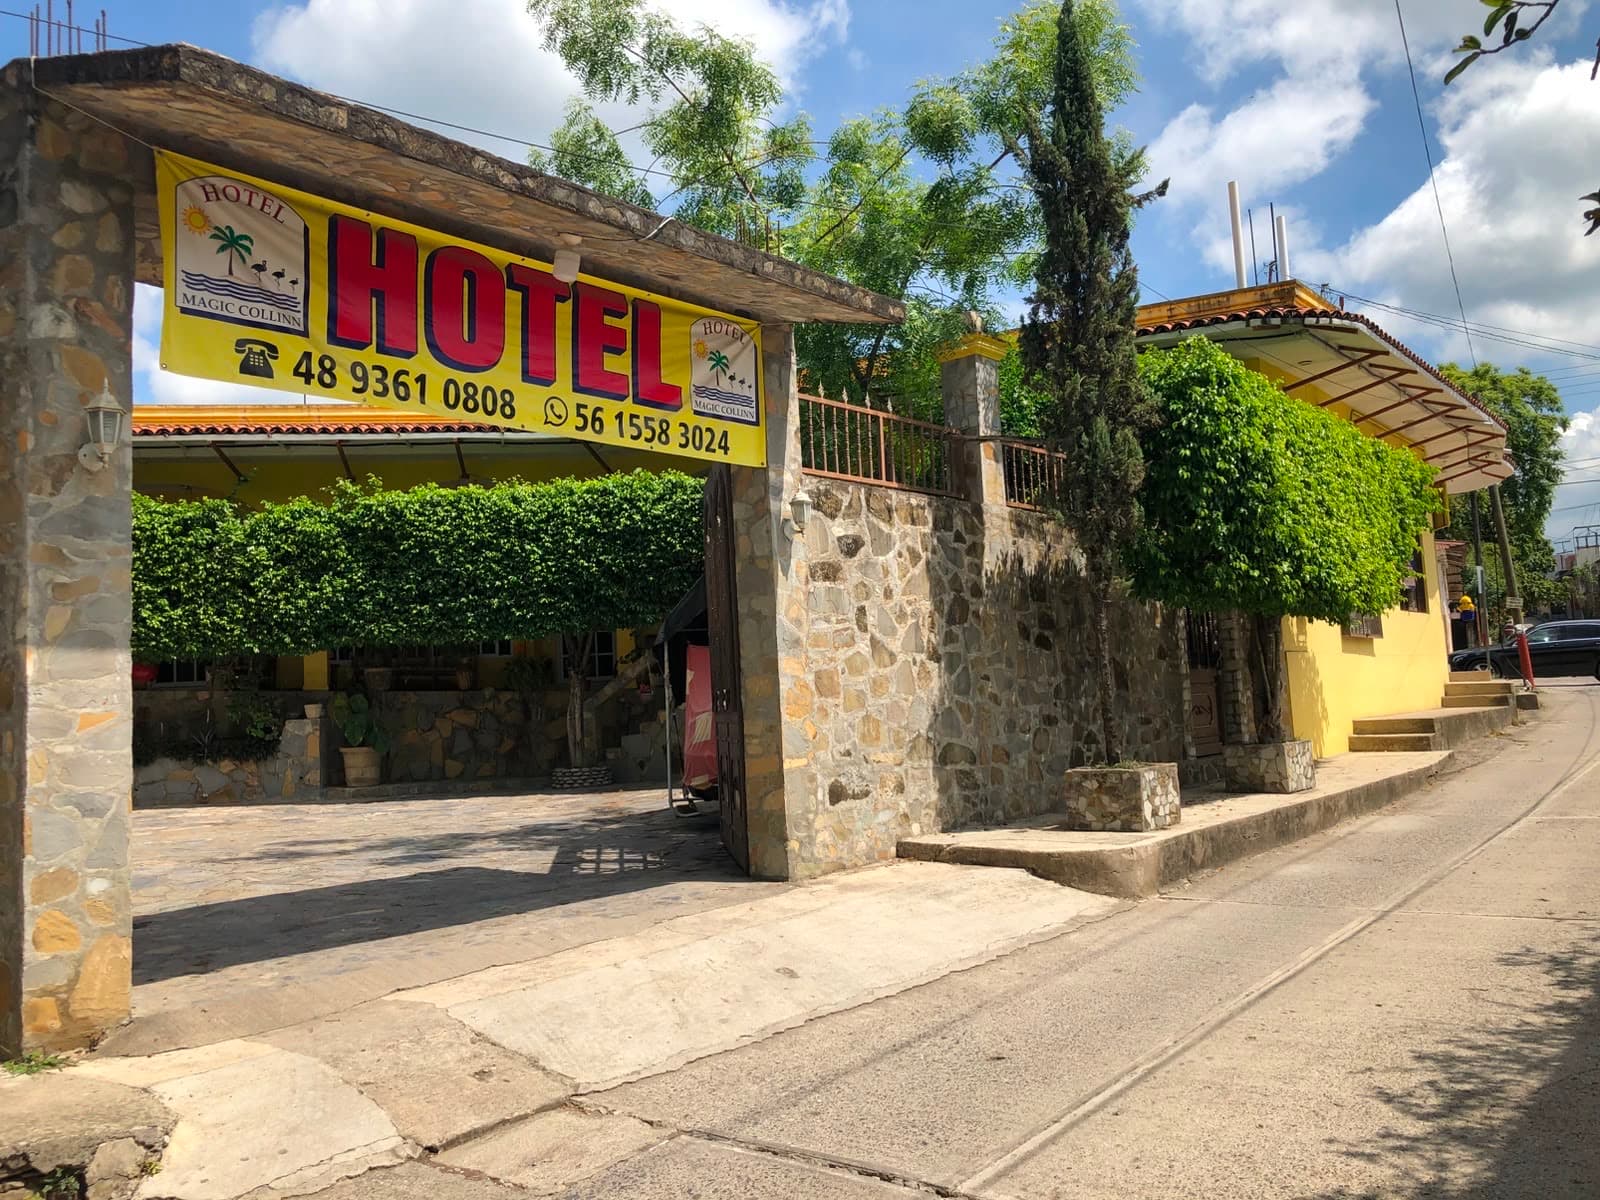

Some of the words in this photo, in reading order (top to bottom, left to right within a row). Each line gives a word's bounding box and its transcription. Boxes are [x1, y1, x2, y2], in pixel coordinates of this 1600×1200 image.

[200, 183, 286, 225] HOTEL
[182, 292, 235, 315] MAGIC
[238, 304, 302, 328] COLLINN
[327, 213, 683, 412] HOTEL
[702, 320, 748, 346] HOTEL
[292, 350, 338, 389] 48
[350, 360, 427, 405] 9361
[442, 377, 516, 420] 0808
[574, 402, 605, 436] 56
[614, 410, 671, 446] 1558
[678, 421, 730, 456] 3024
[694, 399, 720, 414] MAGIC
[720, 405, 755, 420] COLLINN
